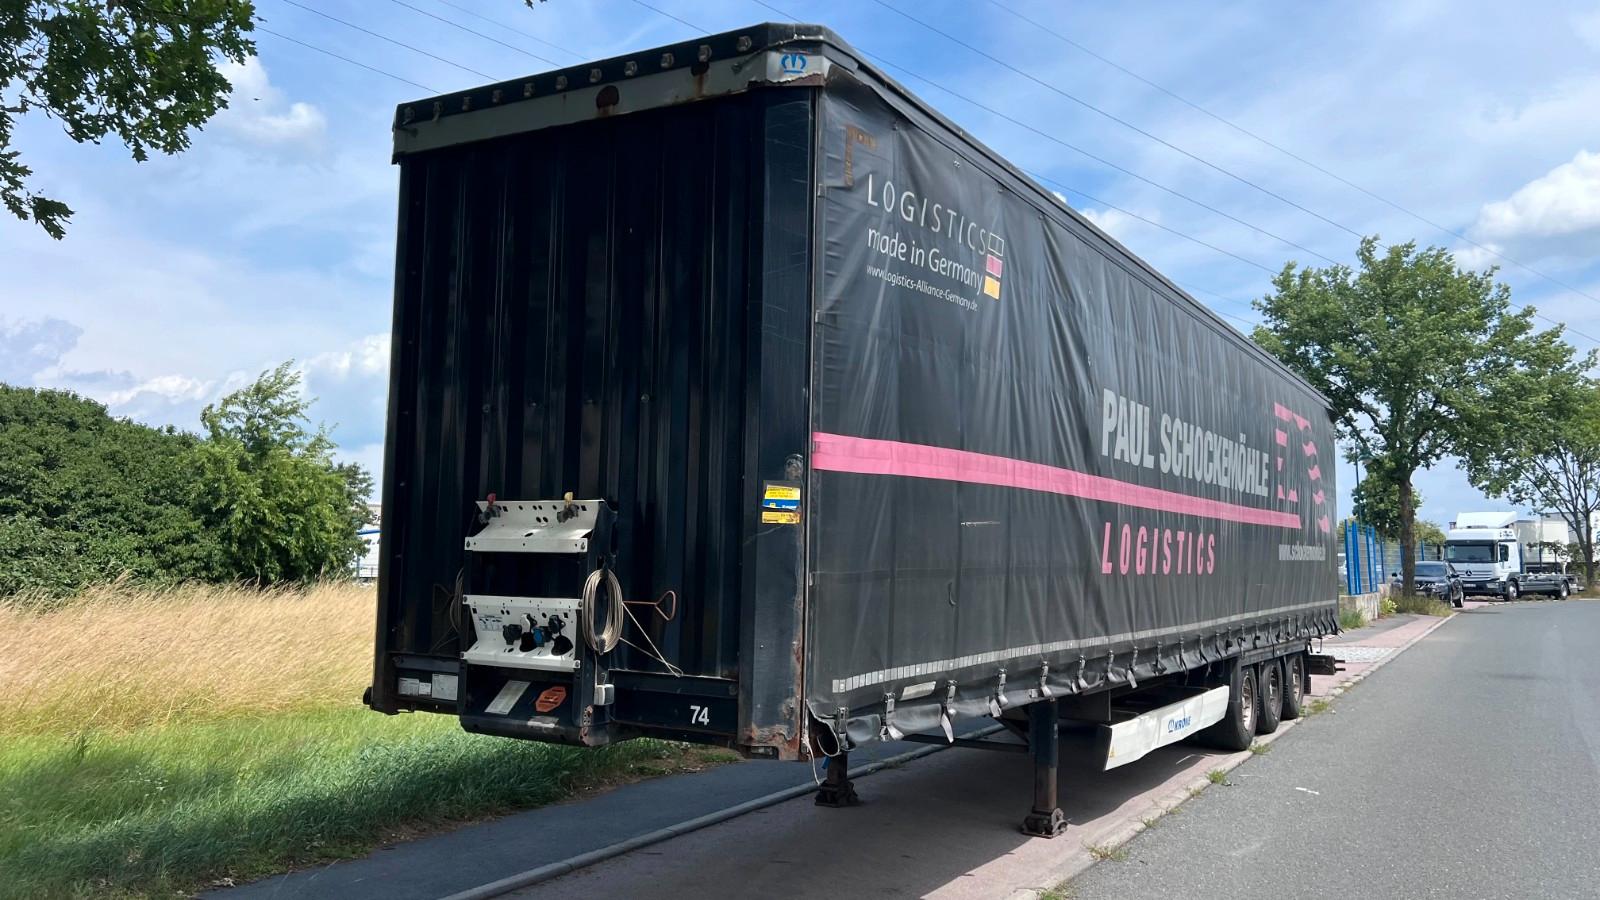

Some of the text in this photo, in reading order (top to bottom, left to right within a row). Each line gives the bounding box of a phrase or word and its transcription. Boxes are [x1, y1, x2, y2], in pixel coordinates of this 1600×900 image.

[867, 174, 986, 255] LOGISTICS
[868, 228, 984, 295] made in Germany
[1101, 388, 1269, 497] PAUL SCHOCKEMÖHLE
[1102, 522, 1215, 575] LOGISTICS
[690, 705, 710, 726] 74
